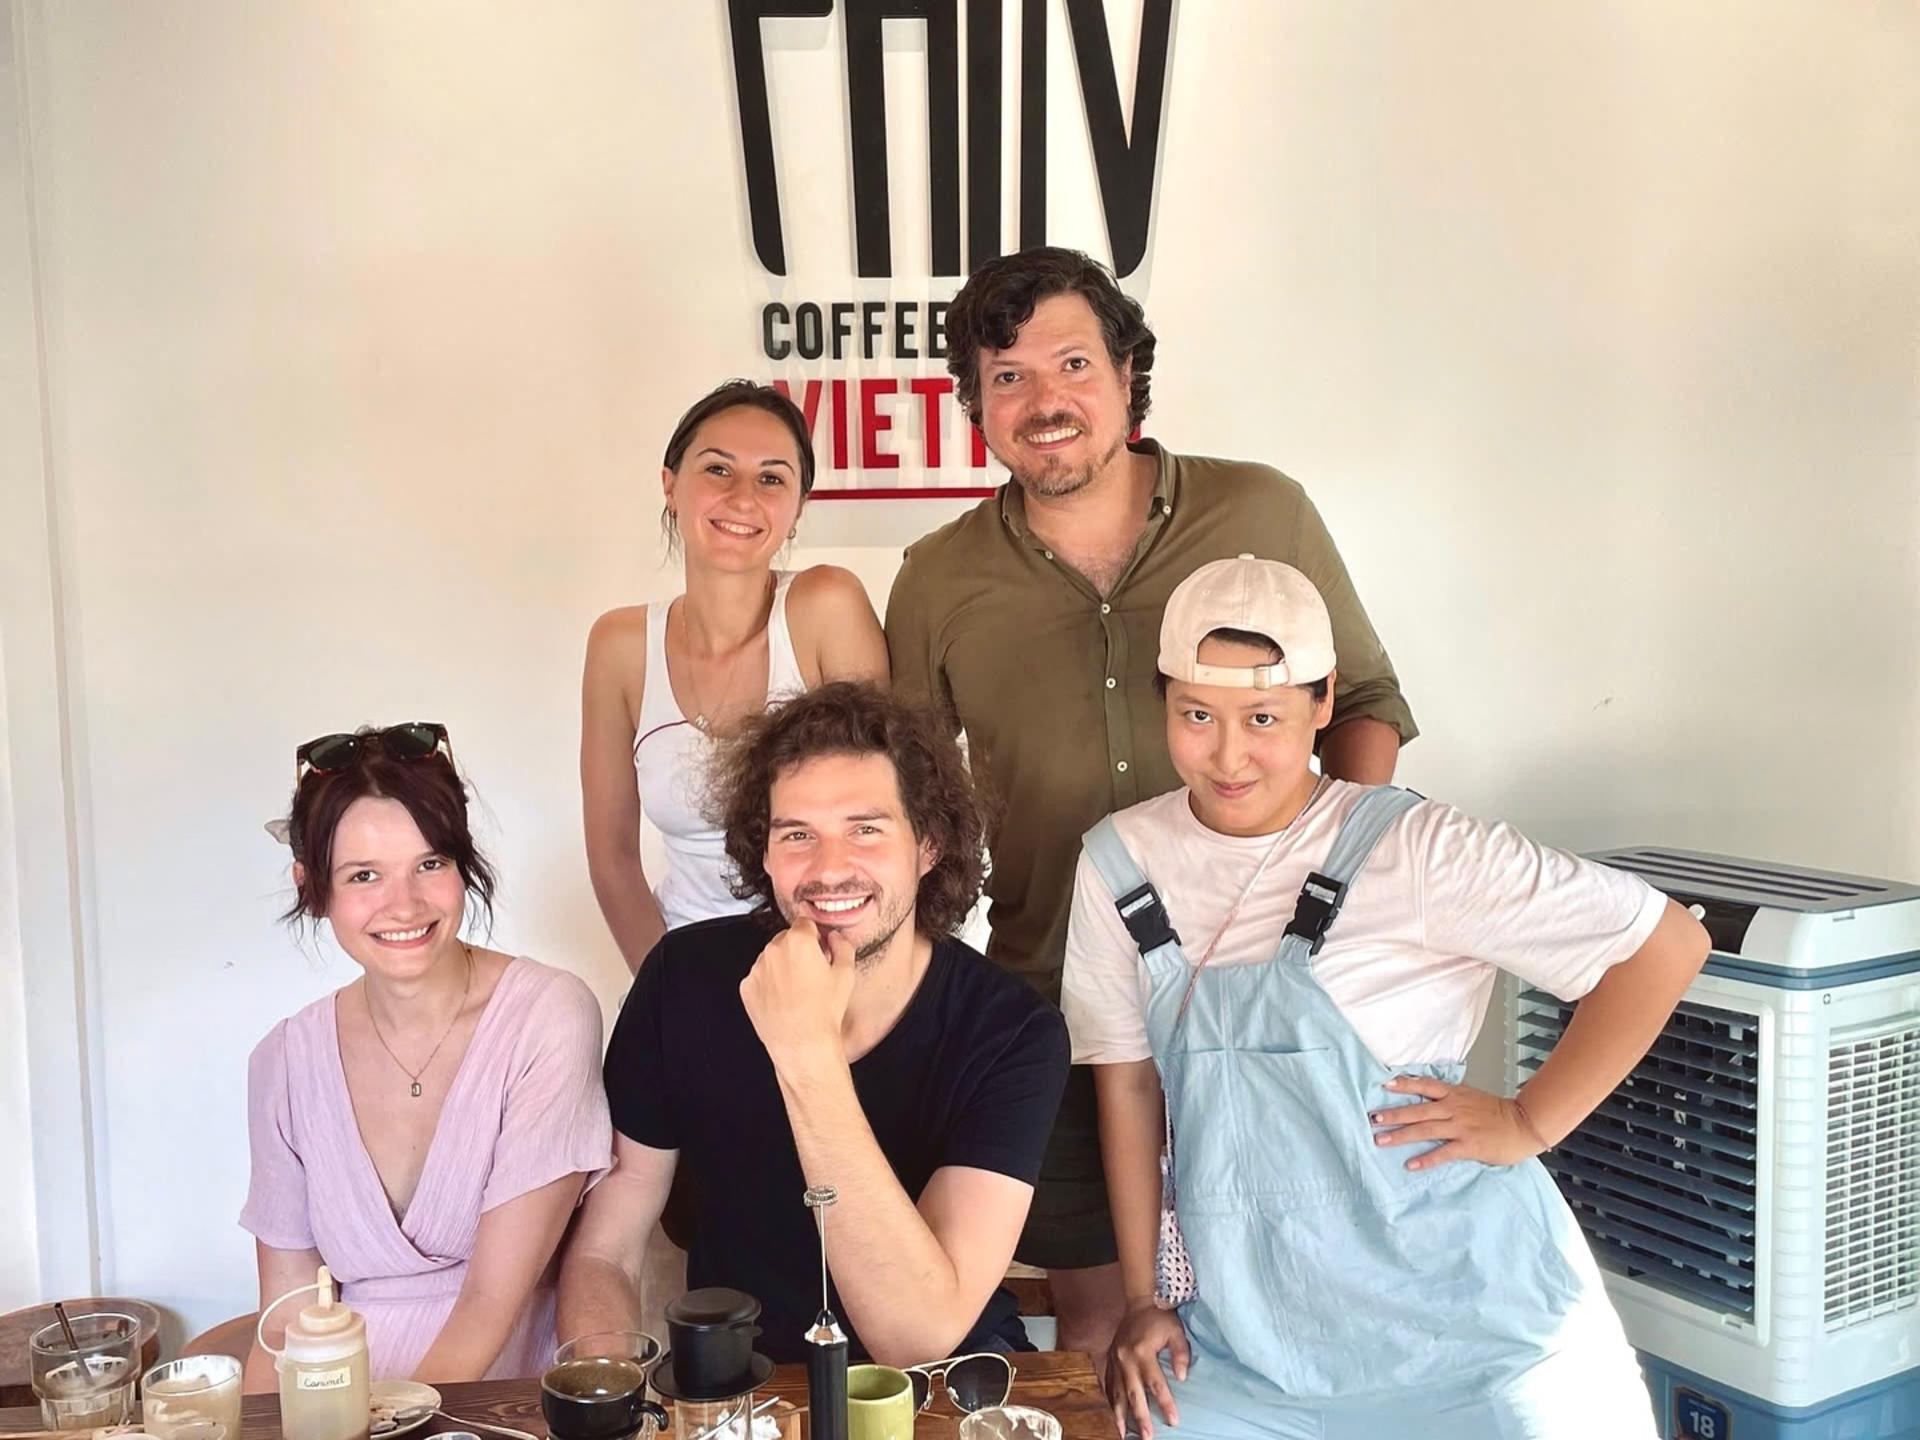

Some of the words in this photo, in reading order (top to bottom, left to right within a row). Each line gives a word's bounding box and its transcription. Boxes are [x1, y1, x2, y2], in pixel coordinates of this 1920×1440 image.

[763, 302, 949, 360] COFFEE
[773, 378, 1140, 469] VIET
[1689, 1411, 1715, 1438] 18
